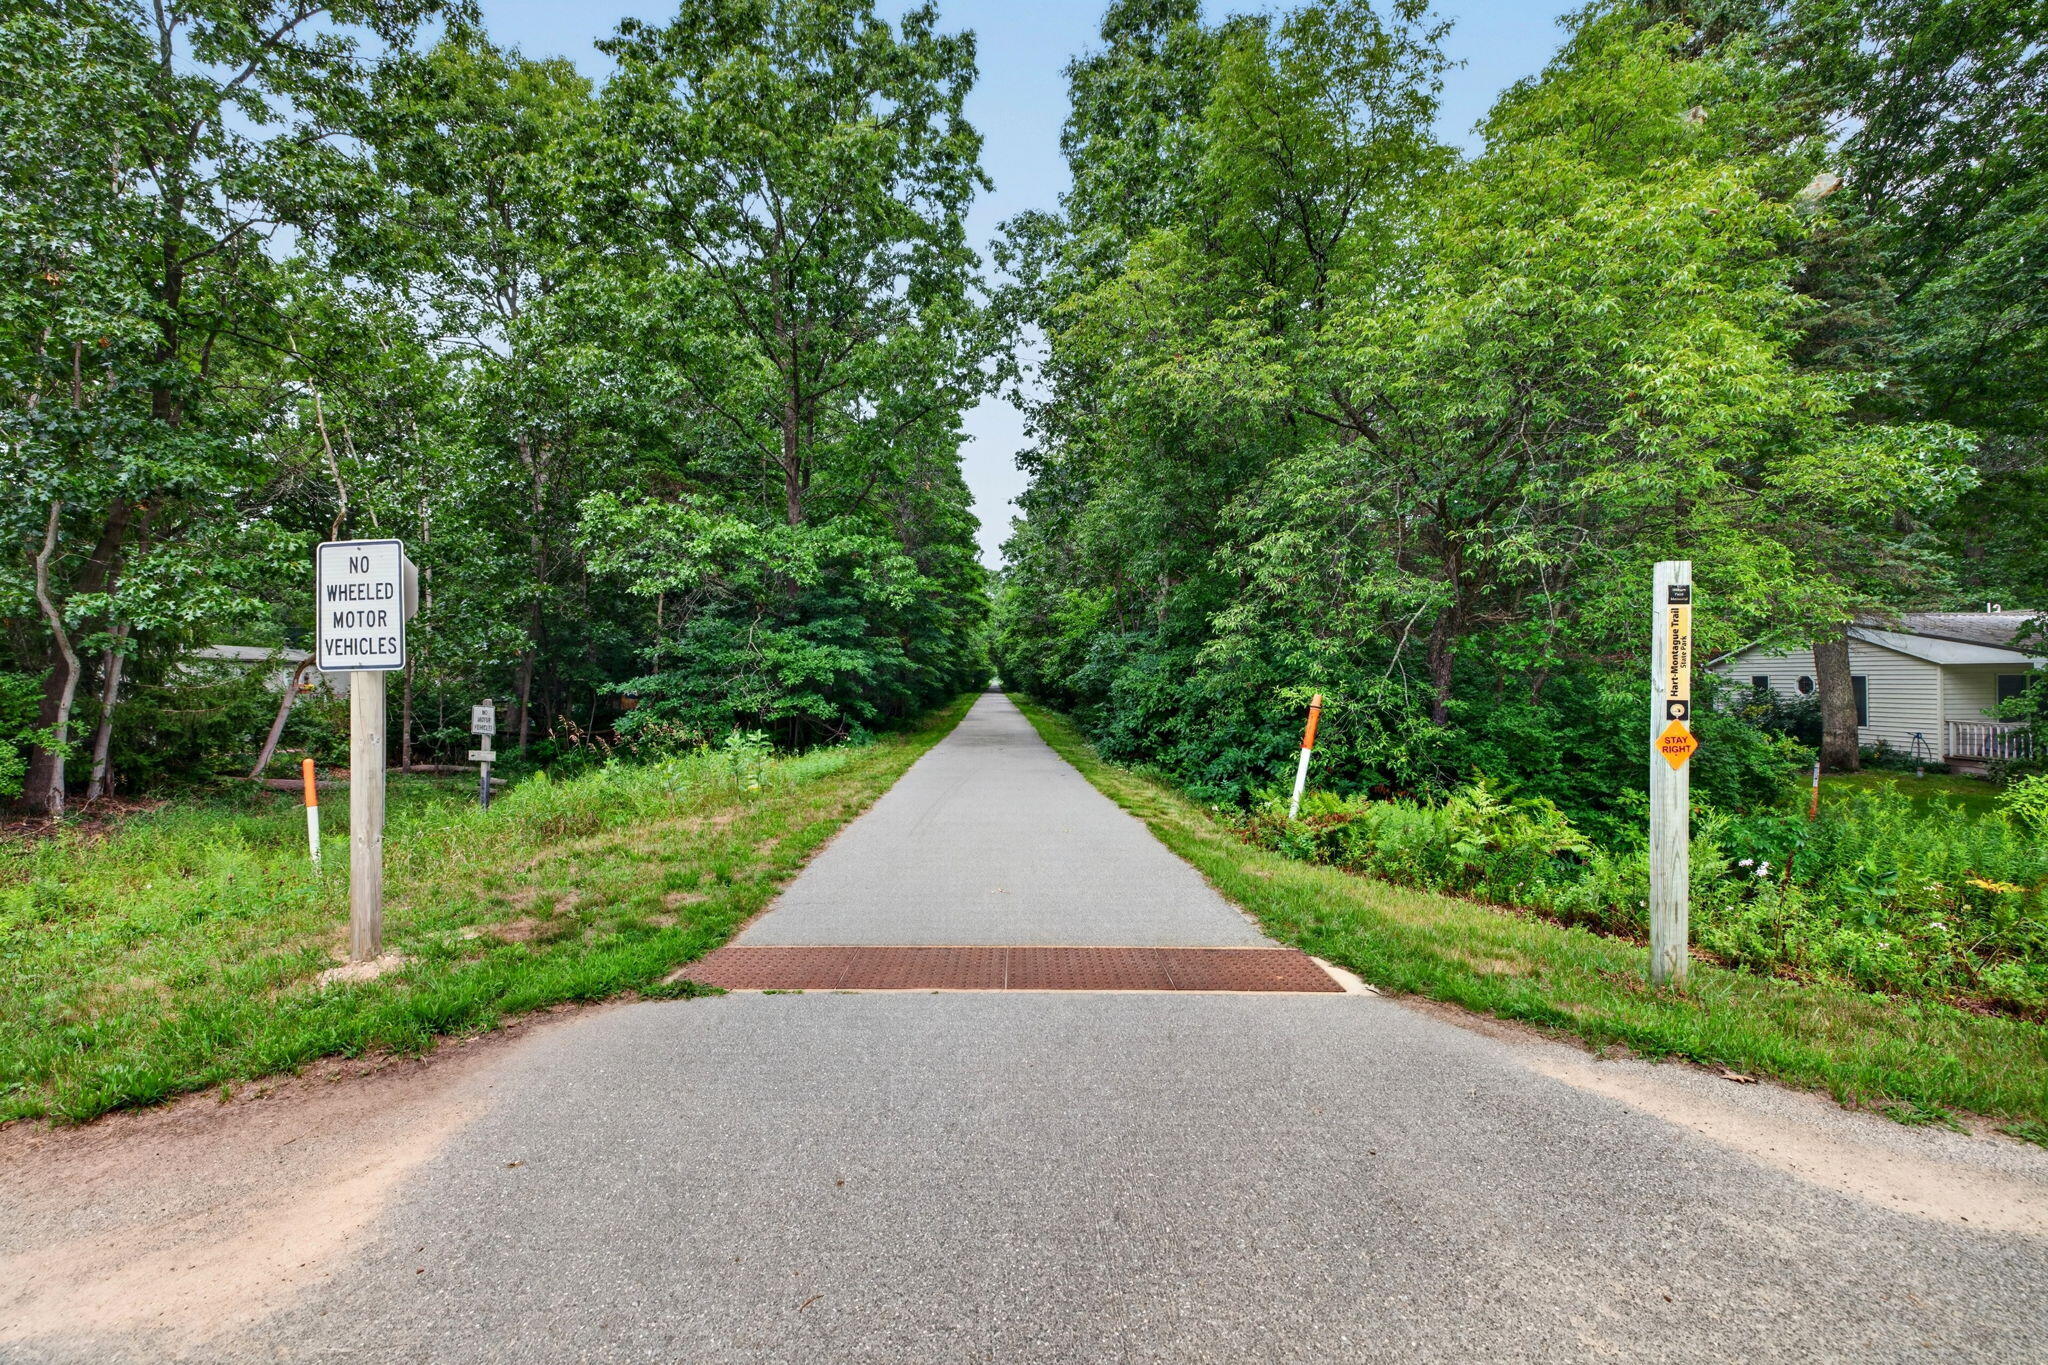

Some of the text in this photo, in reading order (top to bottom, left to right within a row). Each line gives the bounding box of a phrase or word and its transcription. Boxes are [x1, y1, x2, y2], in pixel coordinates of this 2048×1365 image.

[349, 555, 370, 574] NO
[326, 582, 394, 602] WHEELED
[333, 610, 388, 629] MOTOR
[325, 636, 397, 656] VEHICLES
[1670, 607, 1681, 697] Hart-Montague Trail
[1662, 745, 1691, 754] RIGHT
[1664, 736, 1688, 745] STAY
